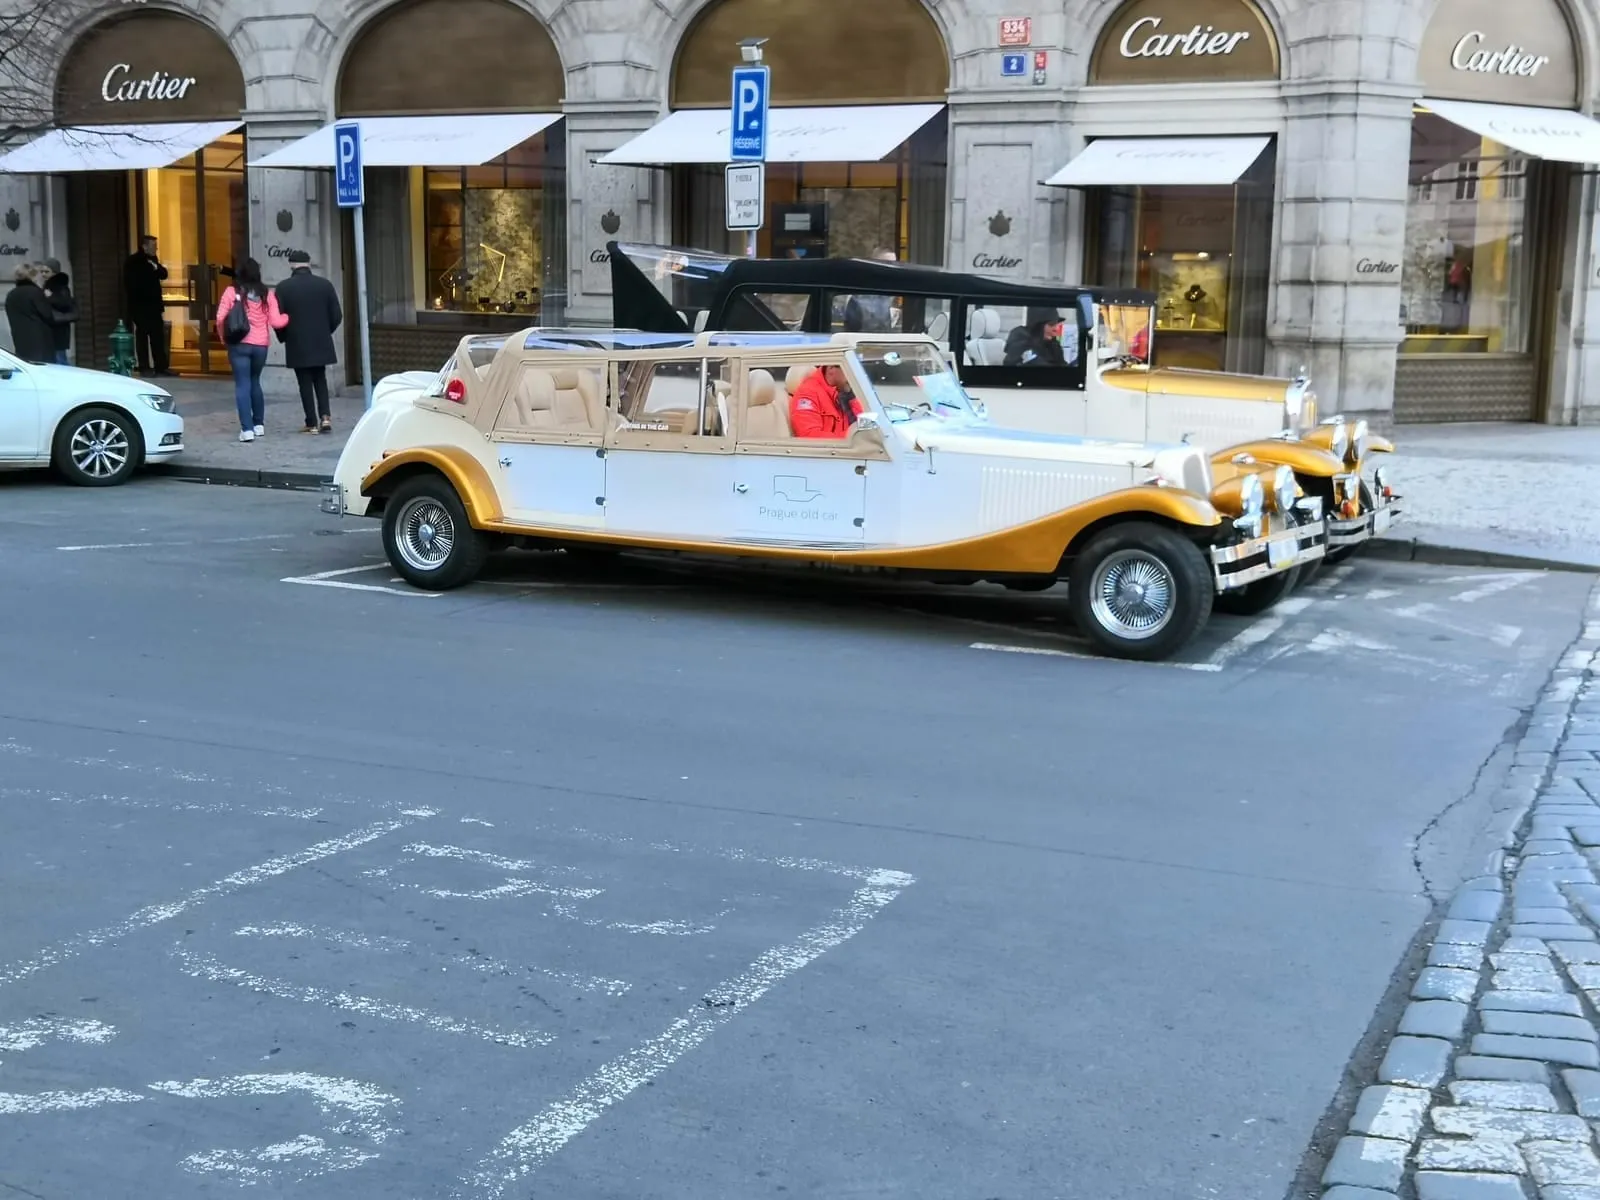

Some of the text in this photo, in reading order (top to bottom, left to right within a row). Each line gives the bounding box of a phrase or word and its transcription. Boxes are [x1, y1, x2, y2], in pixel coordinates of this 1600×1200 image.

[1119, 16, 1249, 58] Cartier
[1010, 58, 1018, 70] 2
[1451, 30, 1549, 76] Cartier
[101, 63, 196, 101] Cartier
[738, 80, 759, 131] P
[340, 134, 354, 181] P
[267, 244, 294, 258] Carti
[972, 252, 1023, 268] Cartier
[1356, 257, 1399, 273] Cartier
[759, 505, 839, 521] Prague old car
